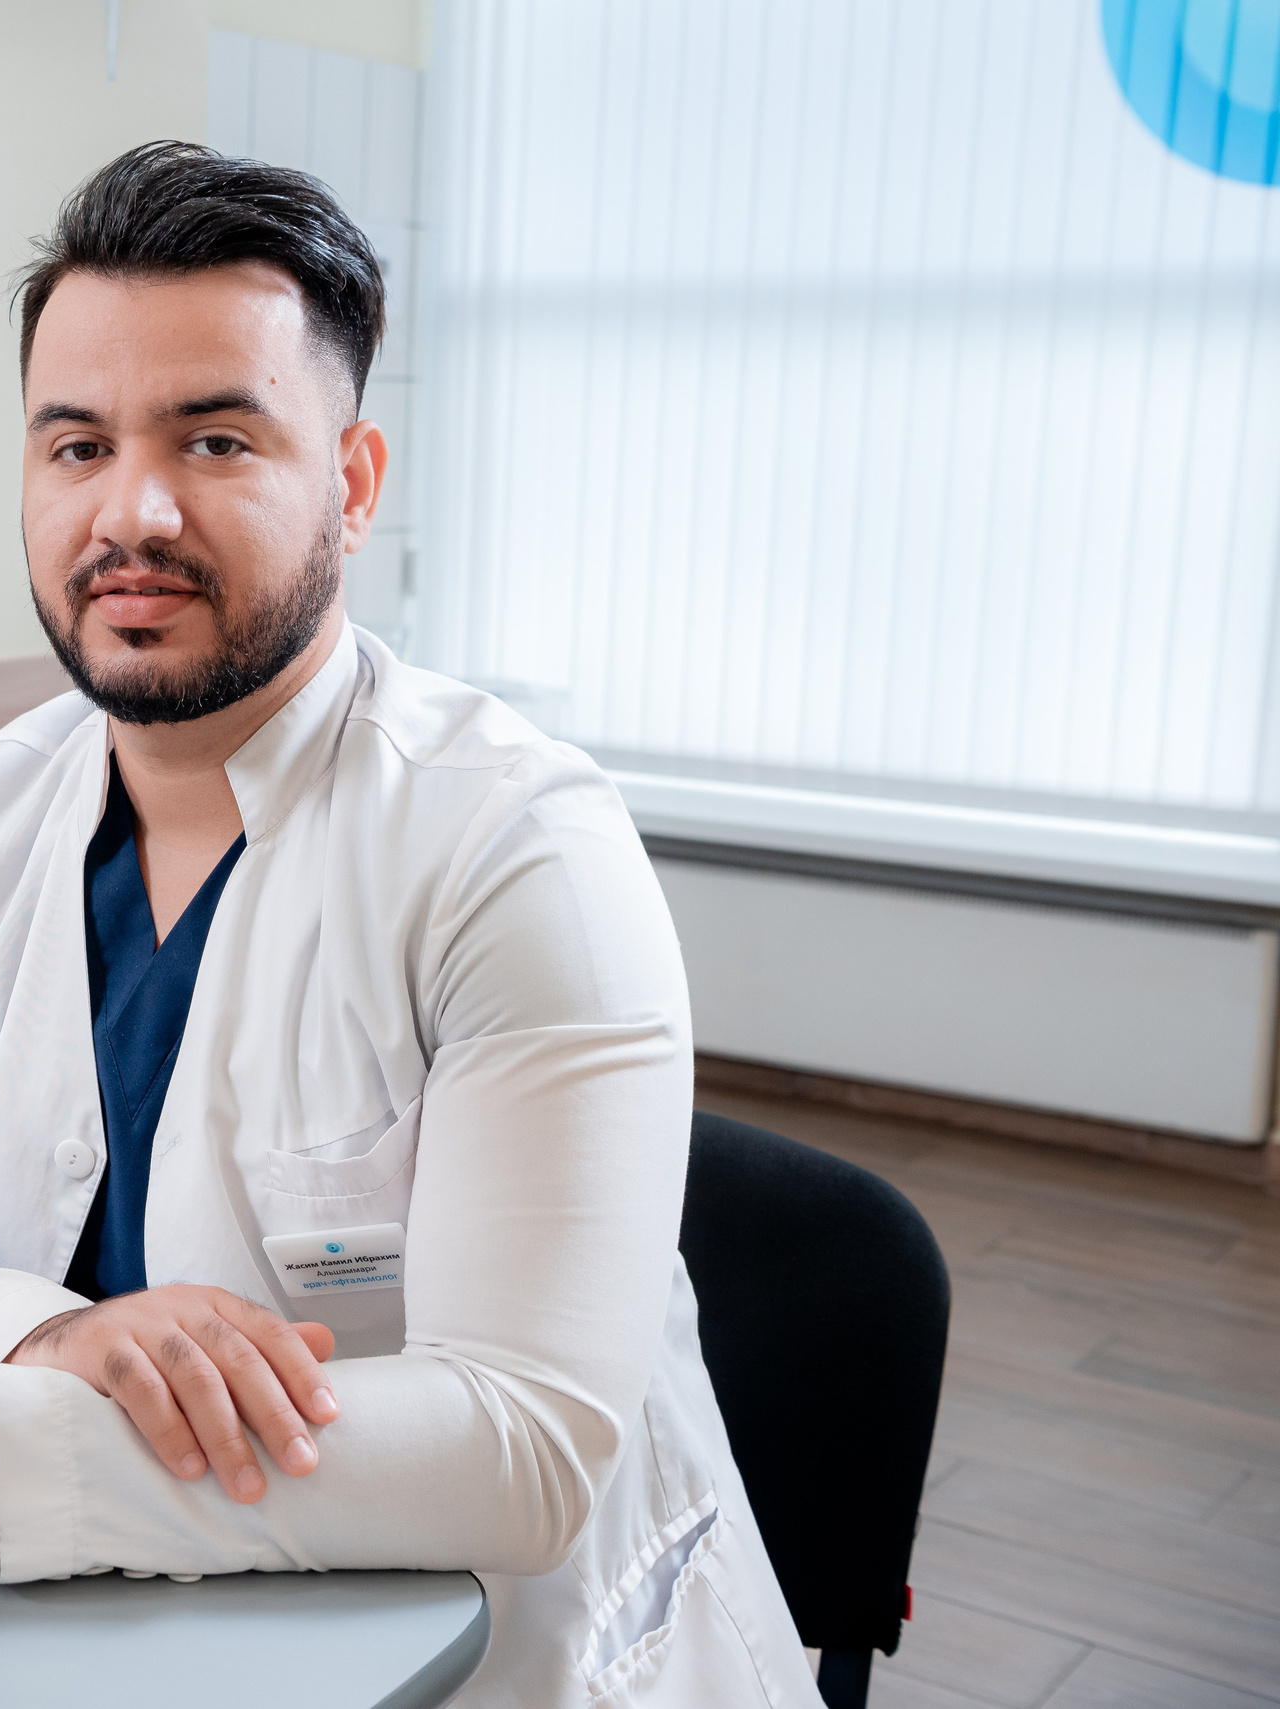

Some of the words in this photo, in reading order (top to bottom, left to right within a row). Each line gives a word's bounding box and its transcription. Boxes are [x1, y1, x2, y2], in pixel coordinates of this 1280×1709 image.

[285, 1262, 319, 1271] Жасим
[320, 1258, 353, 1267] Камил
[354, 1253, 400, 1264] Ибрахим
[317, 1265, 377, 1277] Альшаммари
[303, 1273, 398, 1290] врач-офтальмолог
